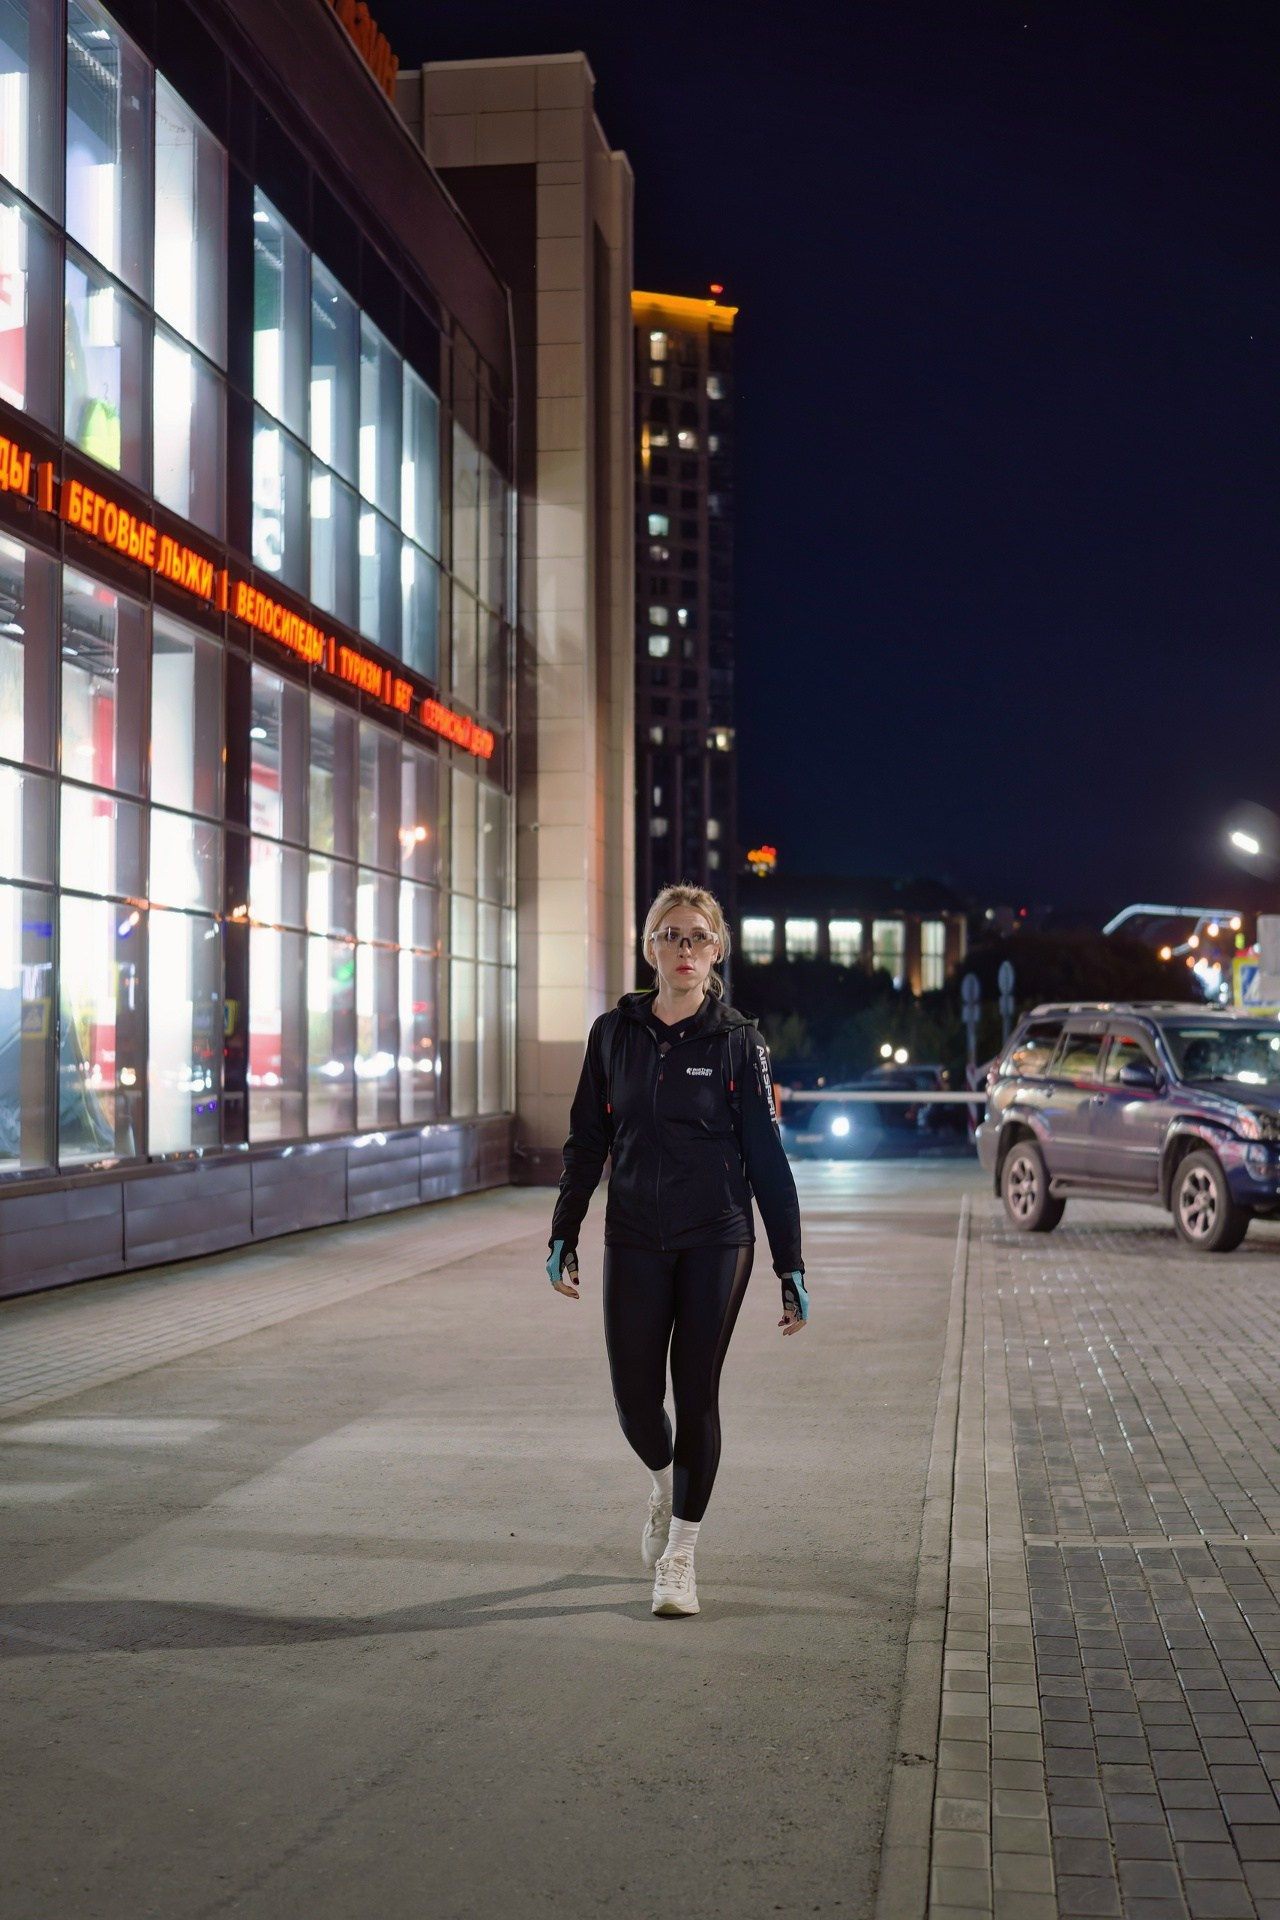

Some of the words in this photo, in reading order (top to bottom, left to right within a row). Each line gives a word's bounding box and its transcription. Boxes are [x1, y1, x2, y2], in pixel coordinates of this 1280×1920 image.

[66, 480, 157, 567] БЕГОВЫЕ
[158, 535, 214, 600] ЛЫЖИ
[235, 581, 324, 664] ВЕЛОСИПЕДЫ
[340, 646, 382, 696] ТУРИЗМ
[394, 678, 413, 713] БЕГ
[756, 1045, 769, 1073] AIR
[763, 1073, 778, 1123] SPIRIT
